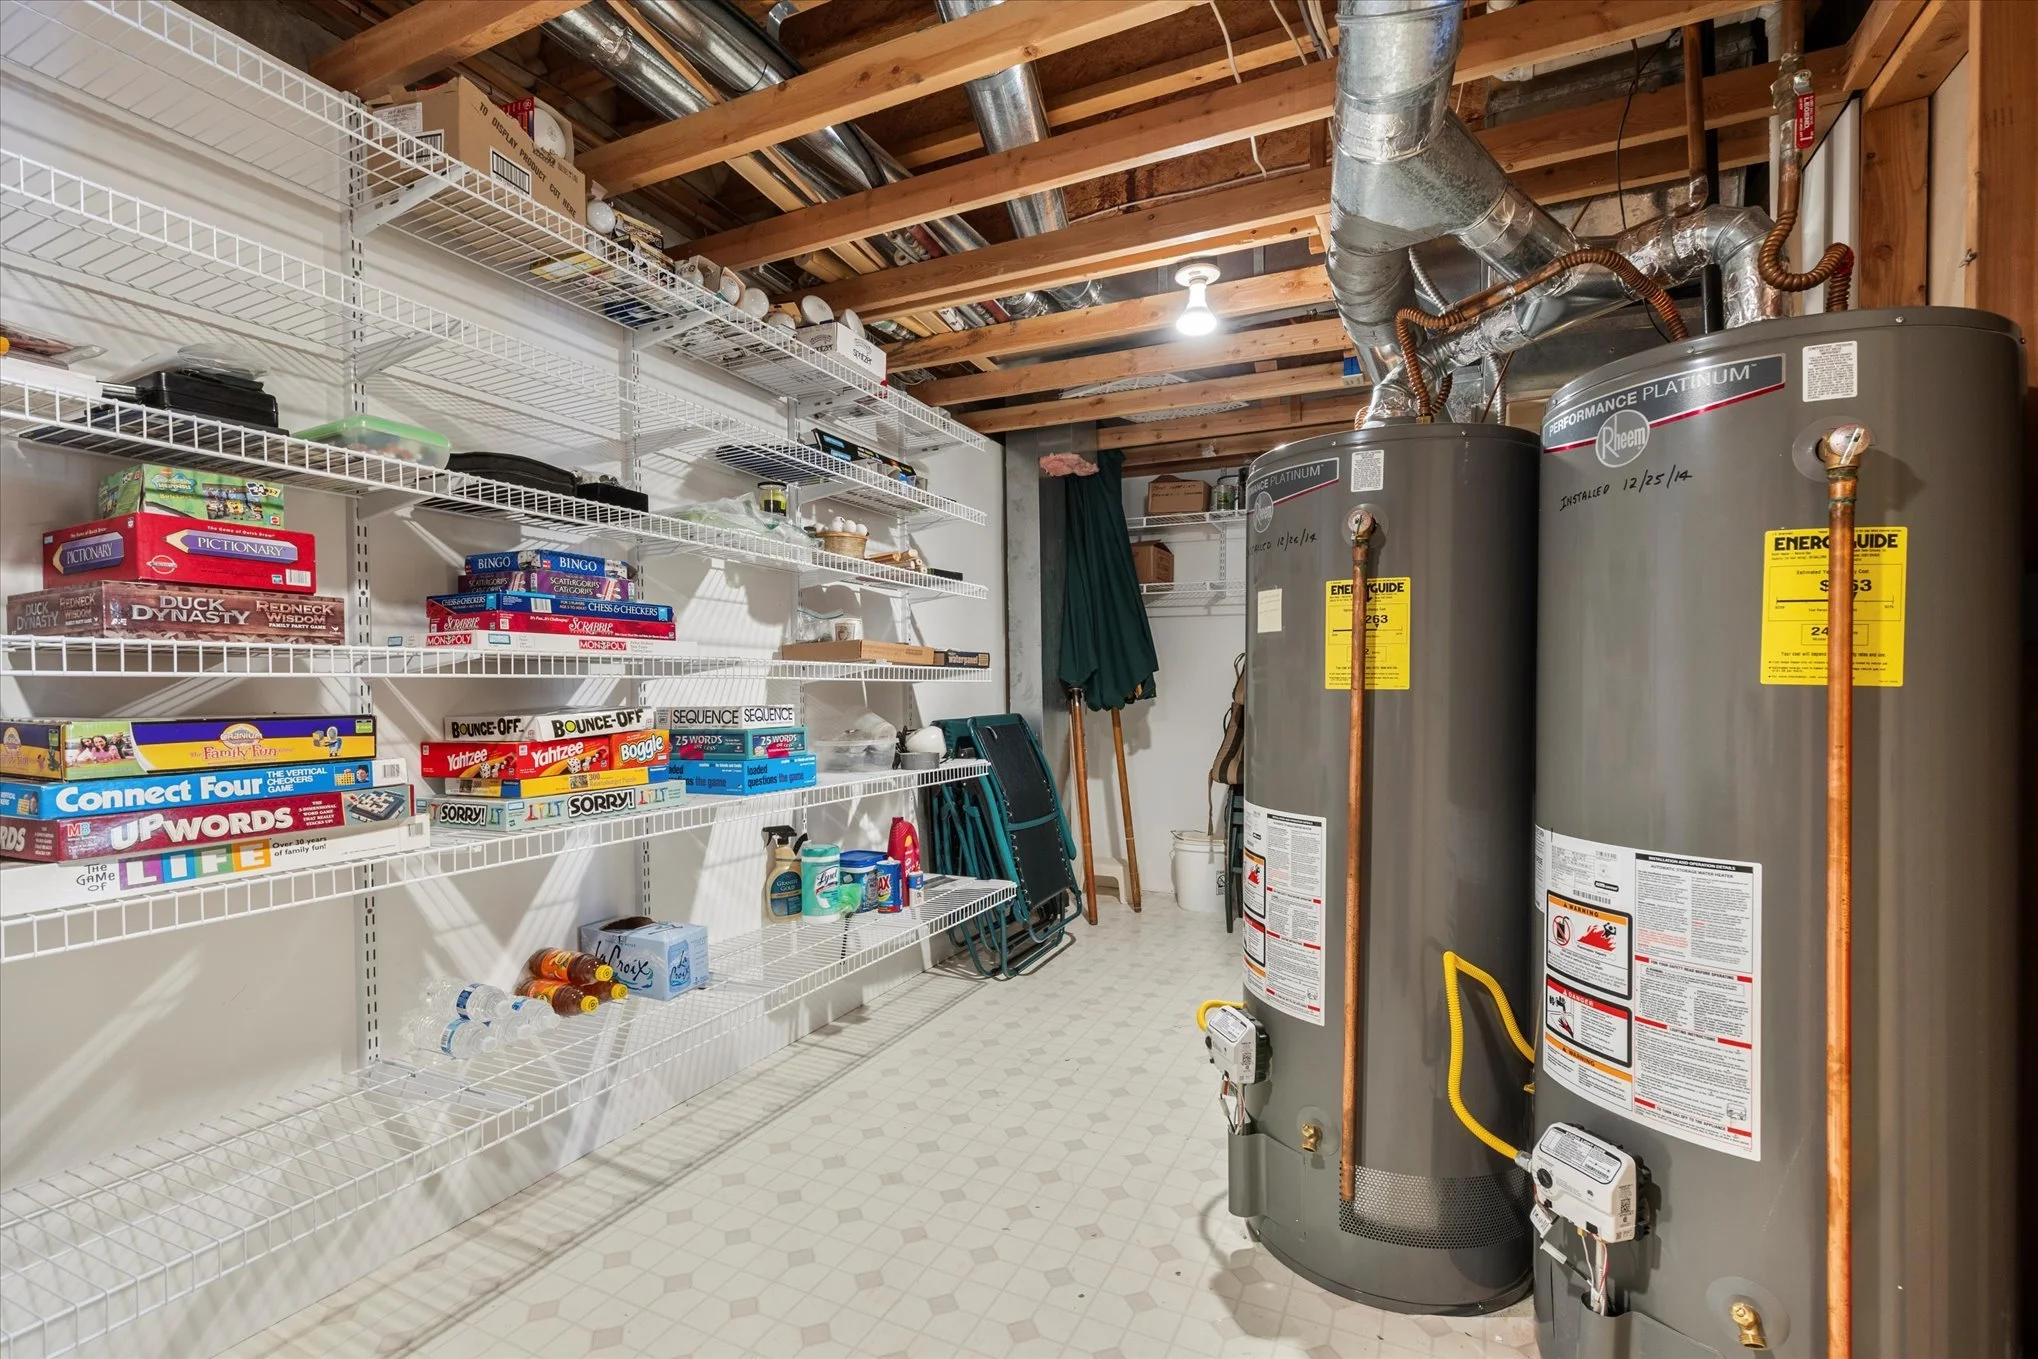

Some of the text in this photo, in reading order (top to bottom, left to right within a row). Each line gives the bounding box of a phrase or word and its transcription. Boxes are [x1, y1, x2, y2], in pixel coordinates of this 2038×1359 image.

[479, 101, 489, 117] TO
[491, 117, 518, 150] DISPLAY
[519, 148, 547, 183] PRODUCT
[549, 183, 561, 199] CUT
[562, 197, 577, 219] HERE
[1549, 364, 1751, 437] PERFORMANCE PLATINUM
[1602, 414, 1646, 461] Rheem
[1270, 465, 1321, 487] PLATINUM
[1560, 465, 1692, 511] INSTALLED 12/25/14
[67, 543, 113, 565] PICTIONARY
[198, 537, 284, 558] PICTIONARY
[478, 556, 510, 569] BINGO
[560, 556, 597, 571] BINGO
[550, 577, 600, 589] SCATTERGORIES
[554, 585, 594, 595] CATEGORIES
[25, 602, 49, 615] DUCK
[59, 594, 96, 610] REDNECK
[159, 595, 225, 611] DUCK
[256, 600, 335, 616] REDNECK
[588, 602, 658, 616] CHESS & CHECKERS
[16, 611, 59, 631] DYNASTY
[64, 608, 92, 619] WISDOM
[131, 604, 251, 626] DYNASTY
[266, 612, 326, 624] WISDOM
[1364, 614, 1389, 624] 263
[444, 616, 480, 630] SCRABBLE
[569, 617, 613, 633] SCRABBLE
[1811, 626, 1829, 636] 24
[427, 634, 471, 646] MONOPOLY
[580, 640, 625, 650] MONOPOLY
[673, 709, 739, 725] SEQUENCE
[744, 707, 793, 723] SEQUENCE
[451, 718, 522, 738] BOUNCE-OFF
[552, 709, 644, 738] BOUNCE-OFF
[621, 734, 663, 762] Boggle
[675, 735, 688, 746] 25
[688, 735, 723, 746] WORDS
[761, 734, 798, 746] 25 WORDS
[203, 746, 247, 761] Family
[252, 744, 277, 758] Fun
[447, 748, 488, 772] Yahtzee
[531, 741, 584, 768] Yahtzee
[267, 766, 327, 778] THE VERTICAL
[589, 773, 600, 781] 300
[747, 764, 767, 776] loaded
[267, 776, 314, 786] CHECKERS
[268, 784, 294, 793] GAME
[748, 772, 804, 789] questions the game
[56, 775, 263, 813] Connect Four
[570, 790, 634, 815] SORRY!
[441, 804, 486, 824] SORRY!
[67, 822, 92, 837] MB
[111, 807, 293, 851] UPWORDS
[272, 841, 293, 849] Over
[306, 837, 327, 846] years
[274, 843, 327, 857] of family fun!
[125, 843, 265, 887] LIFE
[1648, 856, 1678, 864] INSTALLATION
[1690, 861, 1715, 869] OPERATION
[817, 869, 838, 885] Lysol
[88, 882, 108, 892] OF
[1569, 904, 1599, 918] WARNING
[607, 945, 651, 981] Croix
[1568, 991, 1594, 1007] DANGER
[1569, 1049, 1595, 1067] WARNING
